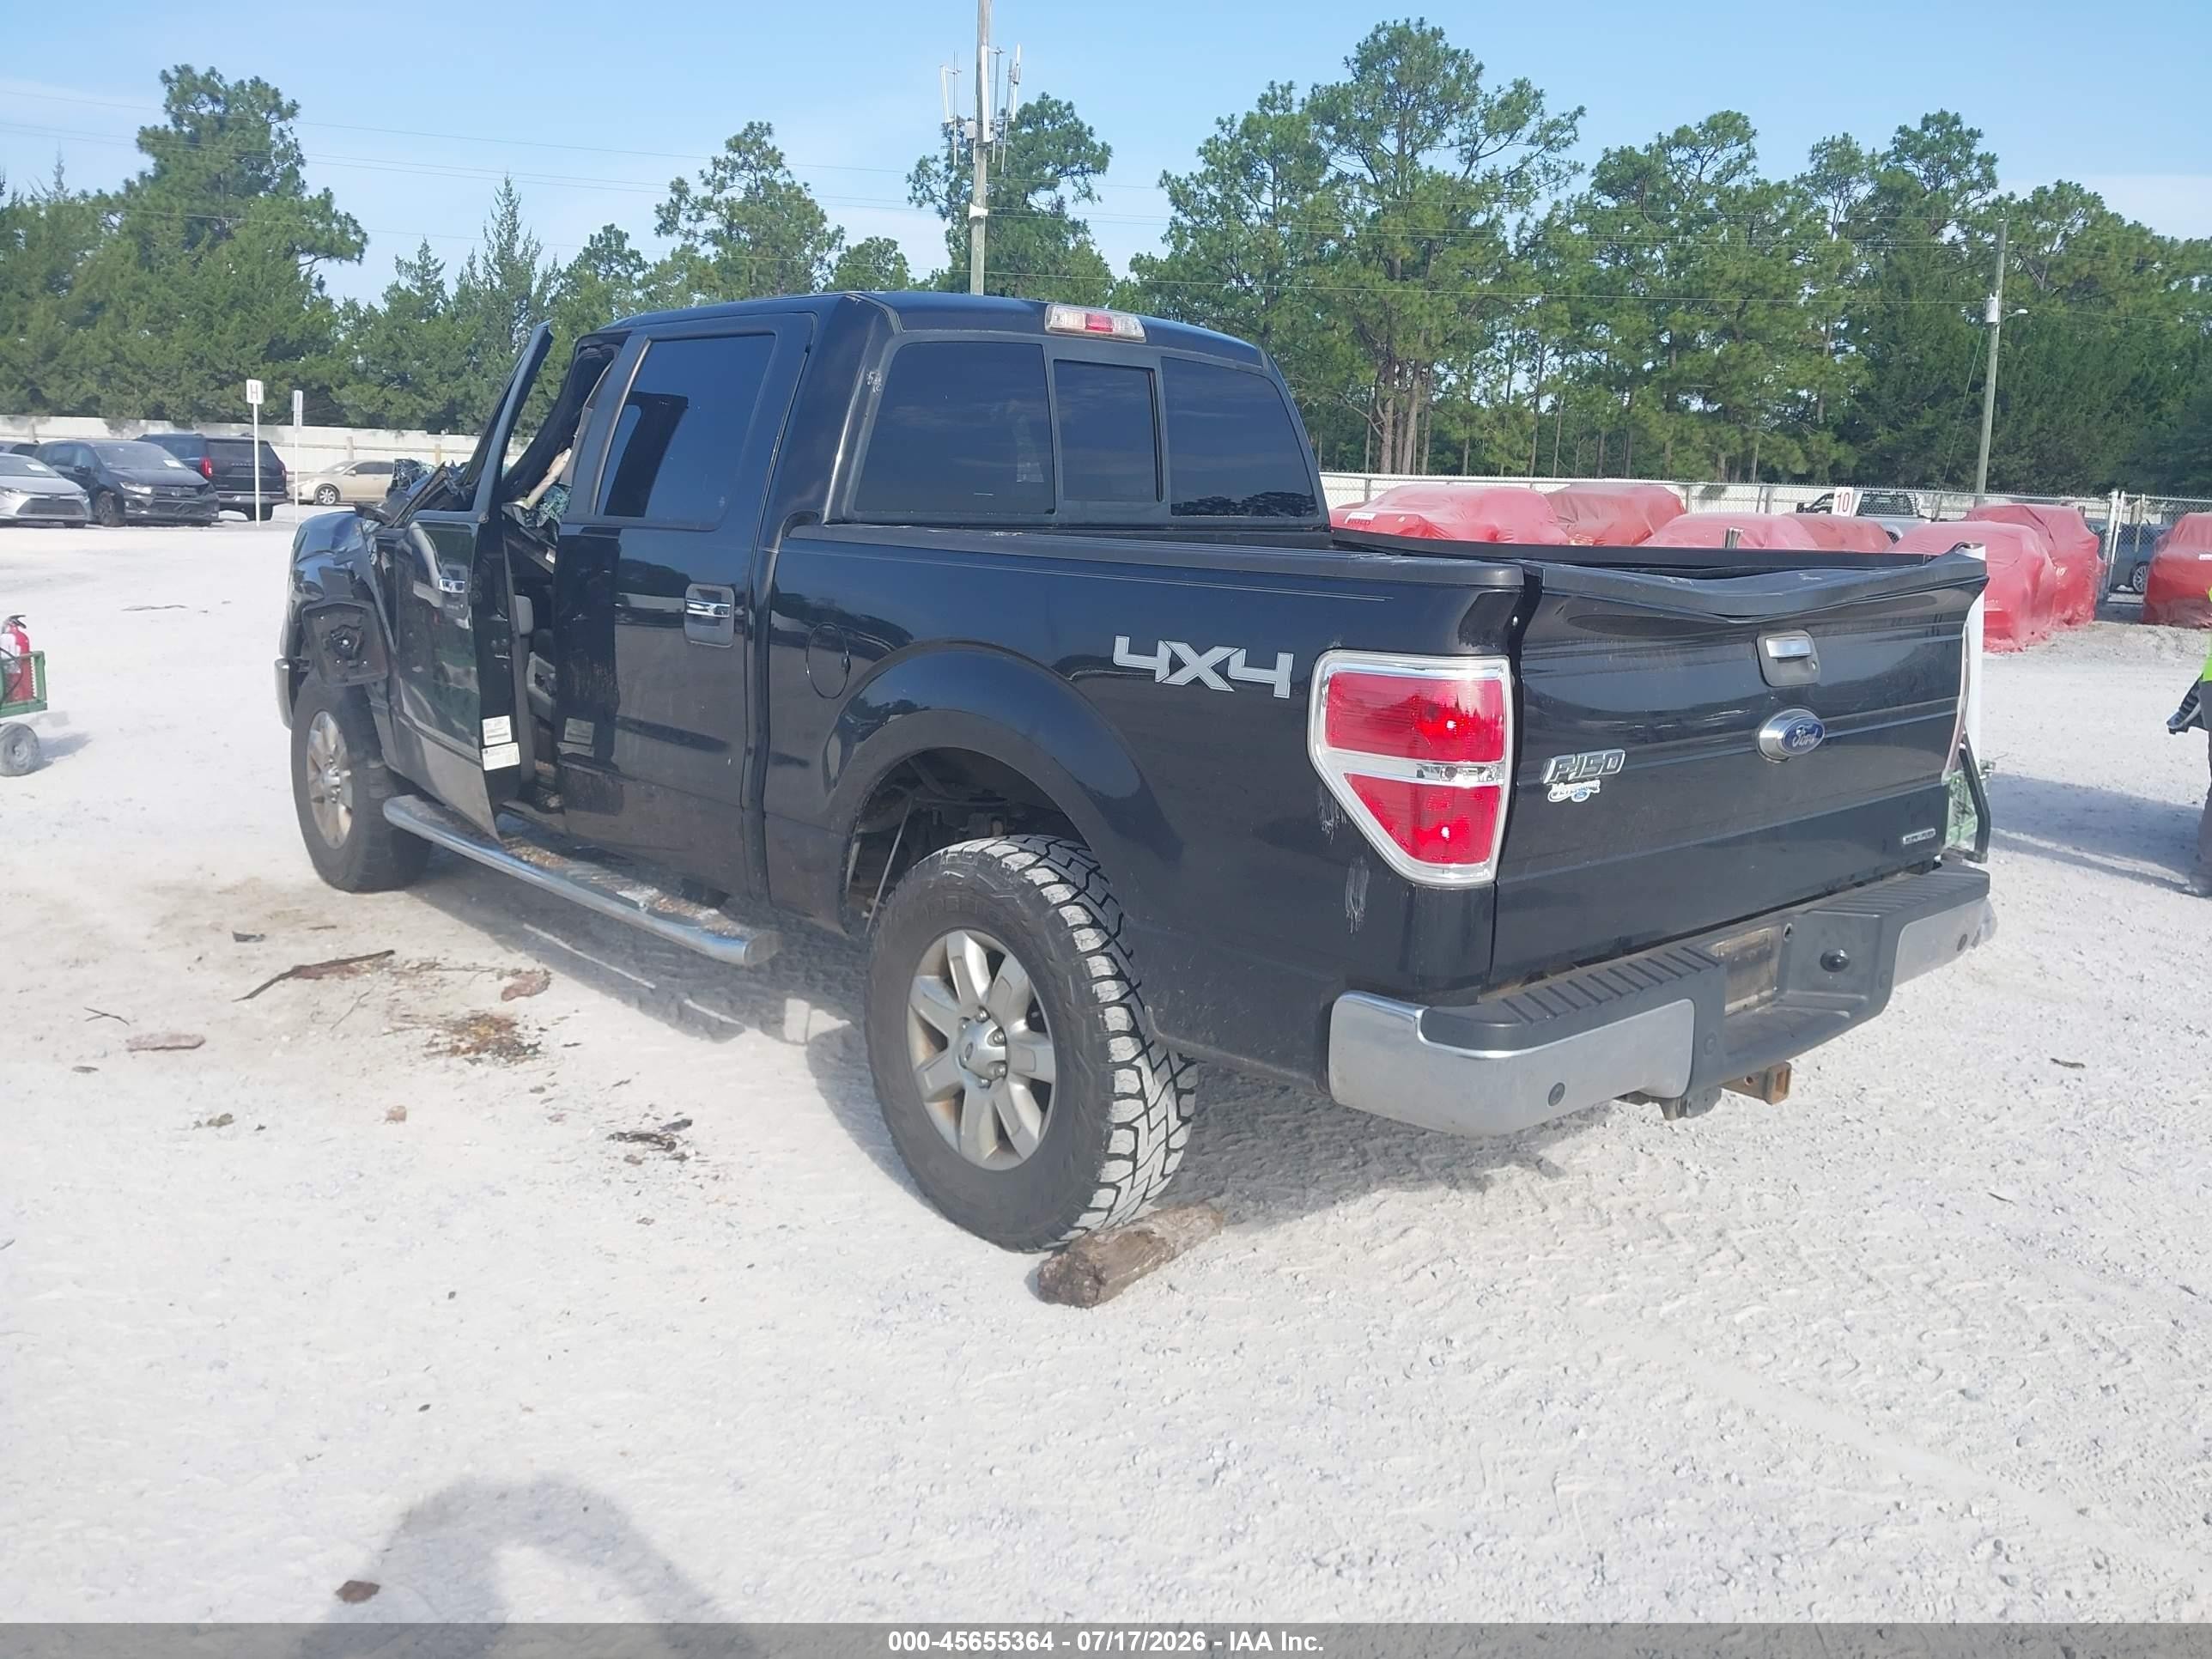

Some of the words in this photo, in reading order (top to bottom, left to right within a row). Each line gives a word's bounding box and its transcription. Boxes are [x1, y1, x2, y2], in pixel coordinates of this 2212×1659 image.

[250, 384, 258, 400] H
[1836, 492, 1850, 513] 10
[1792, 725, 1819, 748] Ford
